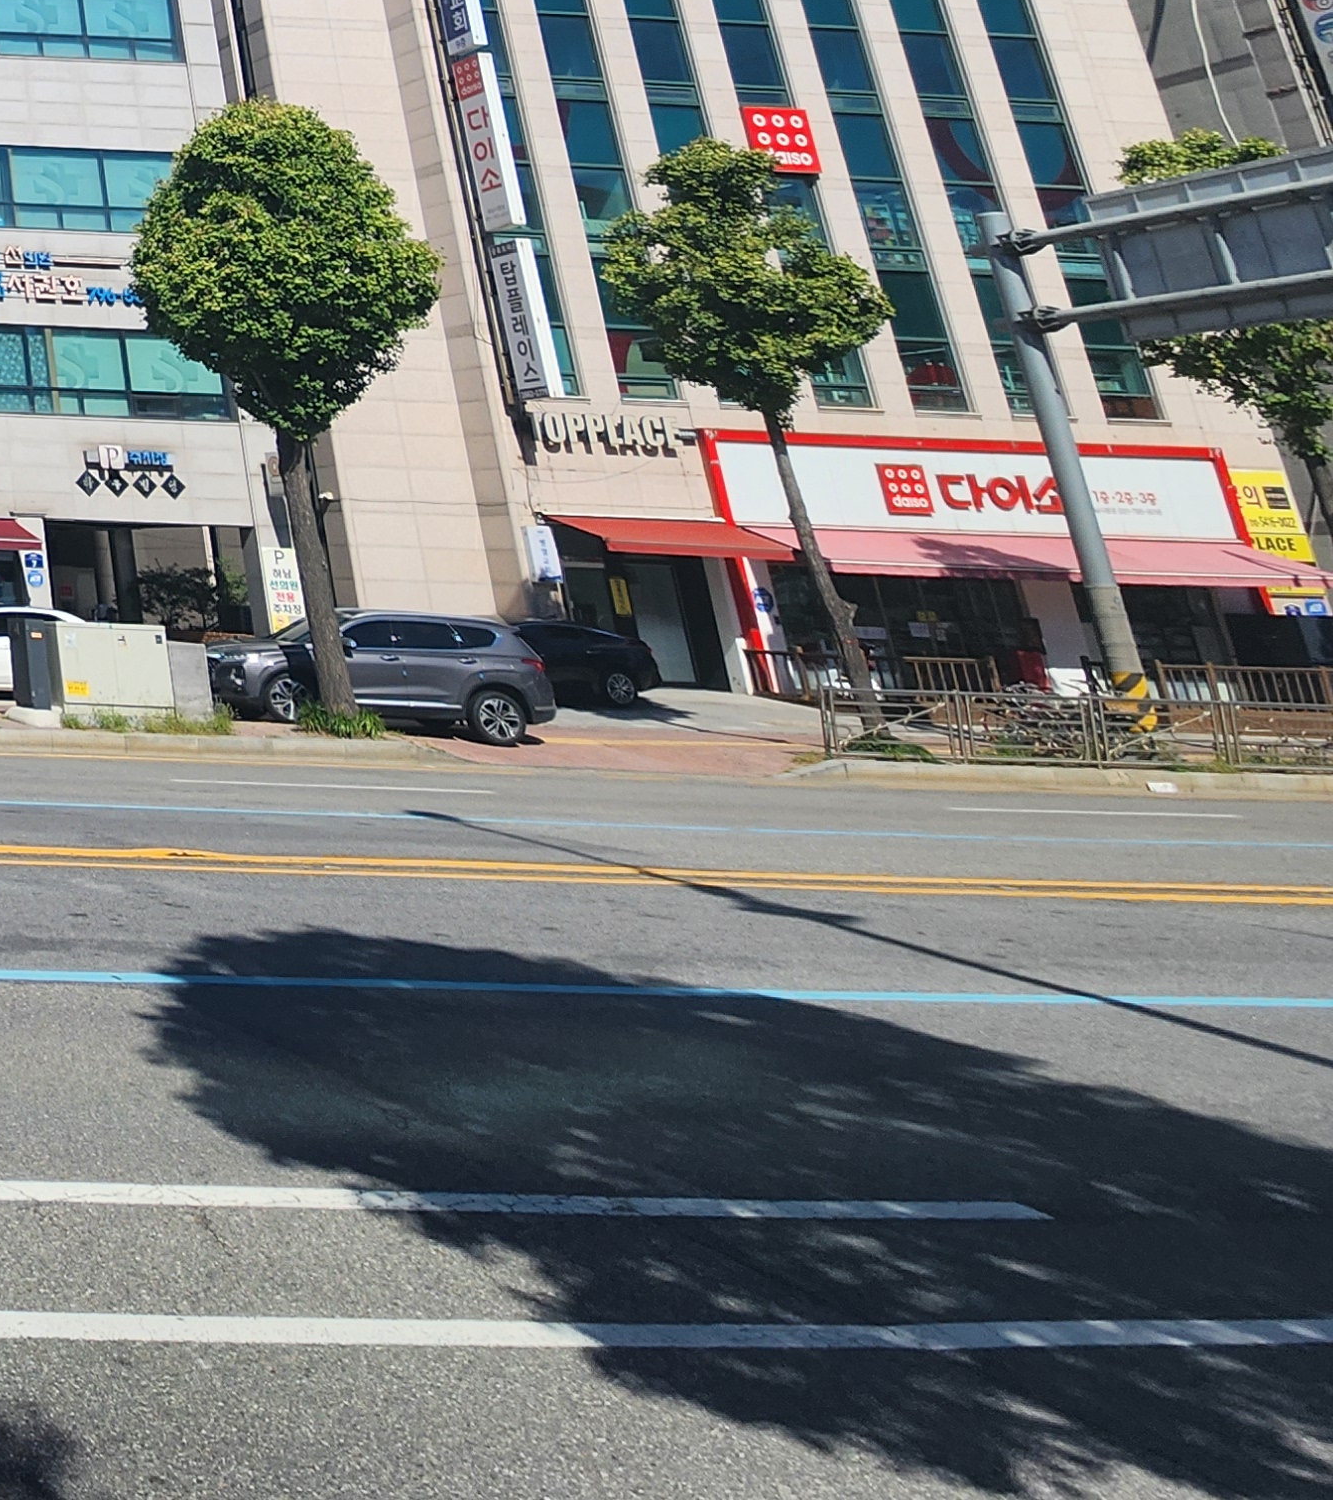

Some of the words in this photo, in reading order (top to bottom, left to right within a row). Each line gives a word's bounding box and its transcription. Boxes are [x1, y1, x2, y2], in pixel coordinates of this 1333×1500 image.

[467, 105, 502, 193] 다이소
[500, 259, 542, 384] 탑플레이스
[535, 411, 686, 447] TOPPLACE
[892, 494, 929, 508] daiso
[274, 549, 285, 565] P
[272, 568, 292, 579] 하남
[269, 580, 299, 591] 선의원
[276, 592, 295, 603] 전용
[274, 604, 302, 615] 주차장
